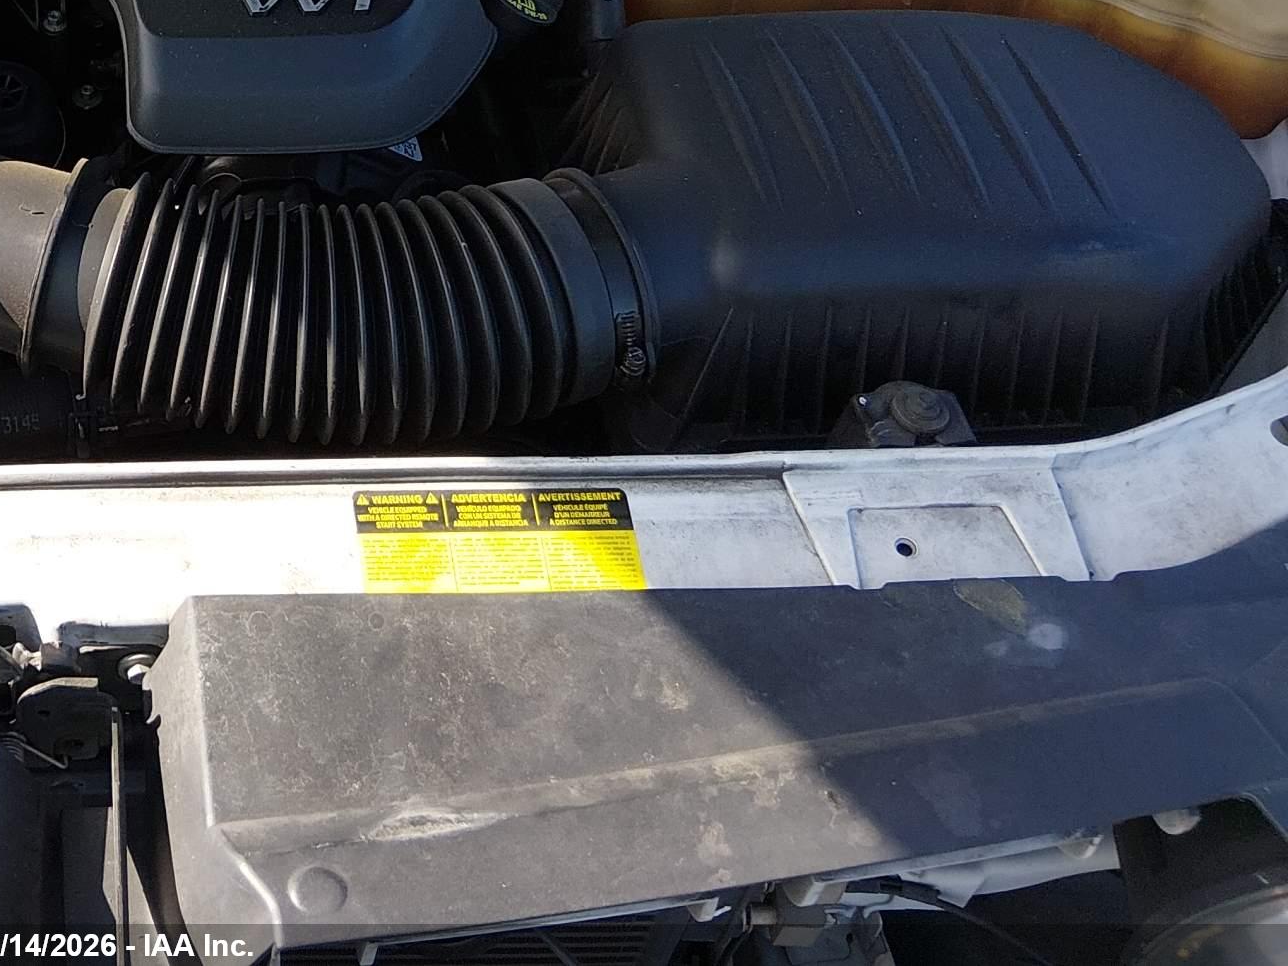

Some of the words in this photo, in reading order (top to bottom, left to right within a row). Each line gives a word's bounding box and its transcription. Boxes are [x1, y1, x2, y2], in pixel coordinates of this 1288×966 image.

[372, 495, 423, 504] WARNING
[452, 493, 526, 503] ADVERTENCIA
[539, 492, 620, 501] AVERTISSEMENT
